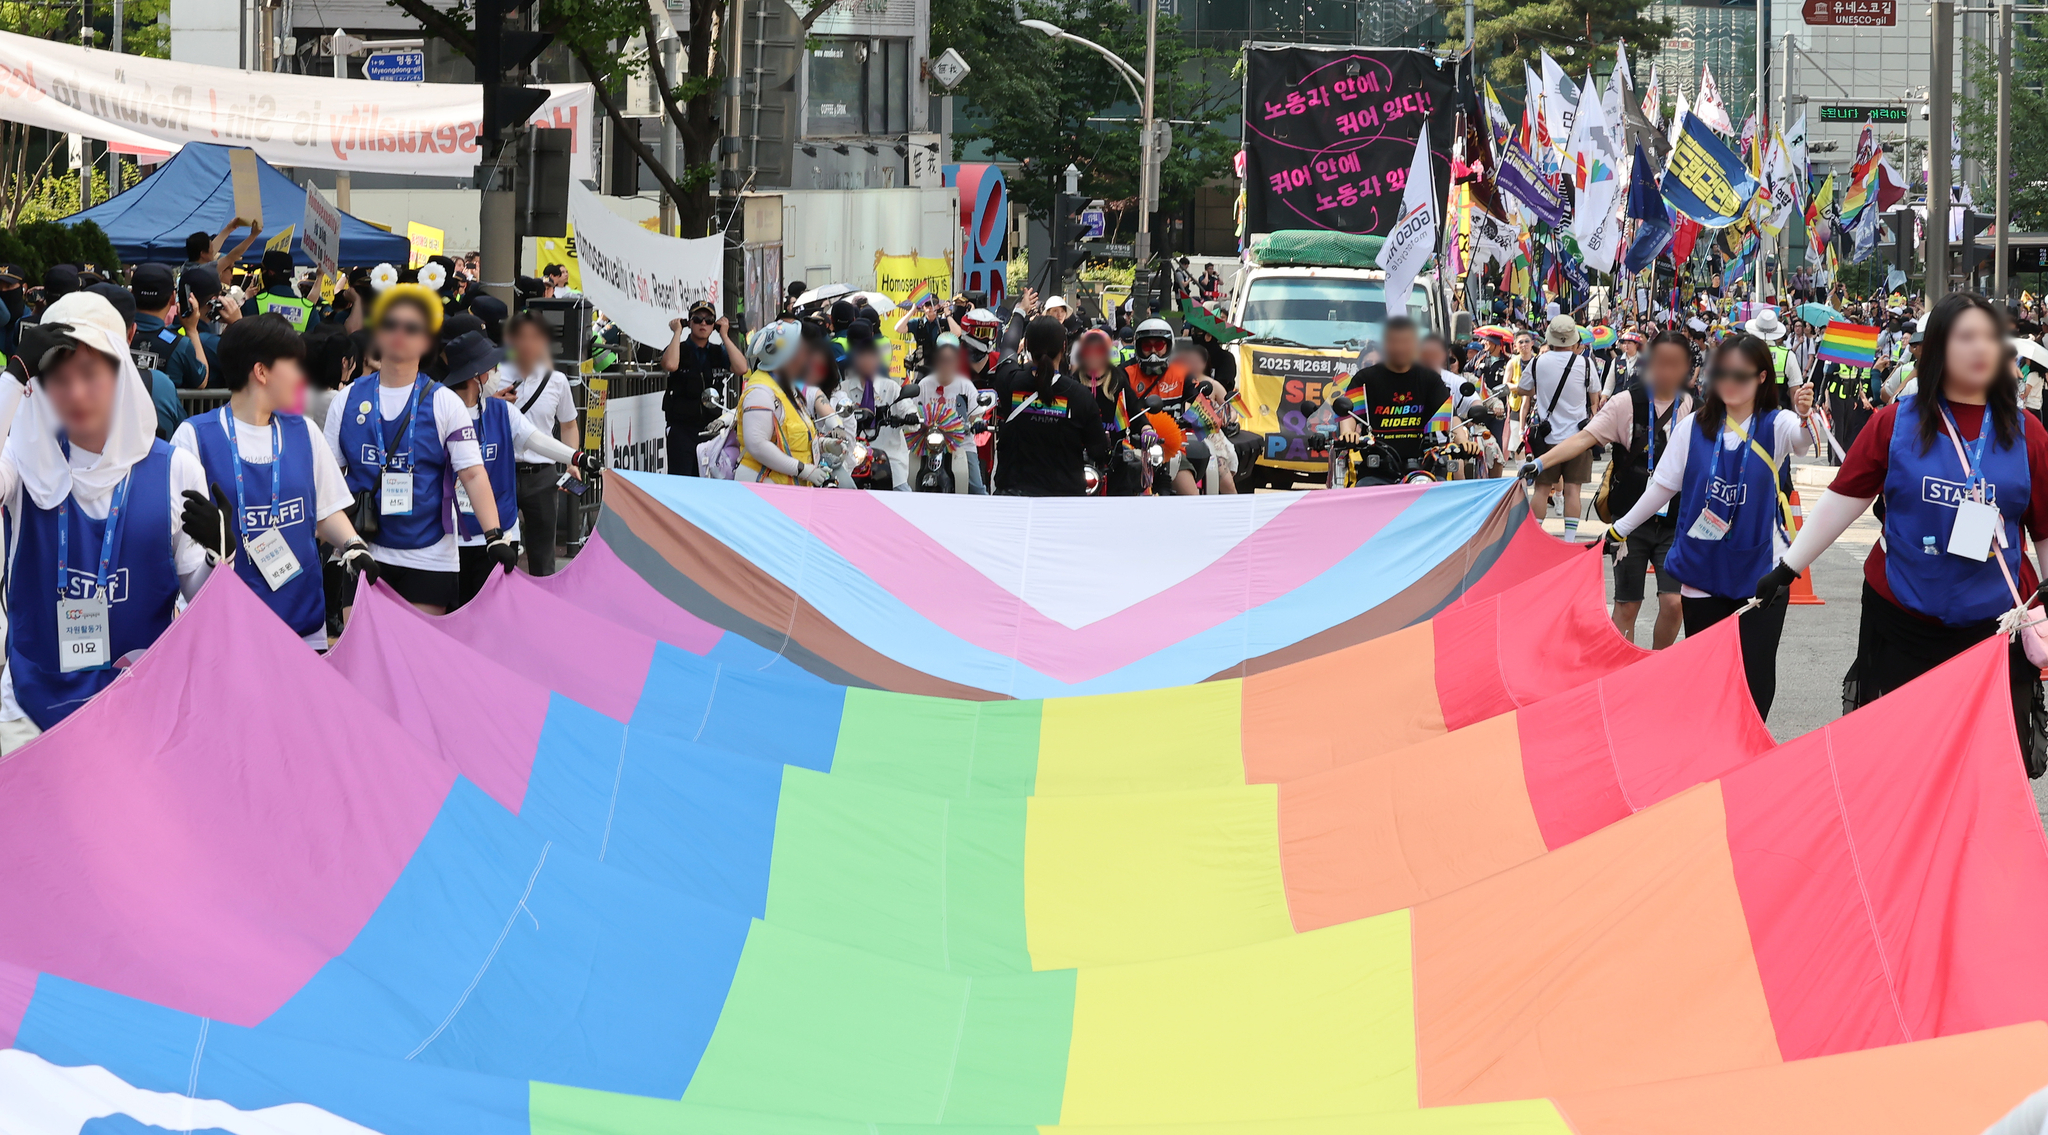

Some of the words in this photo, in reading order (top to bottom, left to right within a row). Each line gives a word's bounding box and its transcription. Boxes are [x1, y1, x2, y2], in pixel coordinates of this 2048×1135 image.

[1833, 2, 1892, 15] 유네스코길
[1836, 16, 1887, 26] UNESCO-gil
[396, 54, 421, 66] 명동길
[371, 66, 421, 75] Myeongdong-gil
[1264, 85, 1331, 121] 노동자
[1333, 71, 1380, 102] 안에
[1335, 105, 1380, 136] 퀴어
[1383, 91, 1434, 122] 있다!
[1269, 165, 1313, 195] 퀴어
[1315, 151, 1362, 182] 안에
[1315, 175, 1382, 212] 노동자
[628, 263, 638, 299] is
[941, 277, 948, 292] is
[1259, 357, 1292, 371] 2025
[1293, 359, 1332, 374] 제26회
[1380, 417, 1422, 428] RIDERS
[66, 624, 103, 635] 자원활동가
[72, 642, 97, 655] 이요
